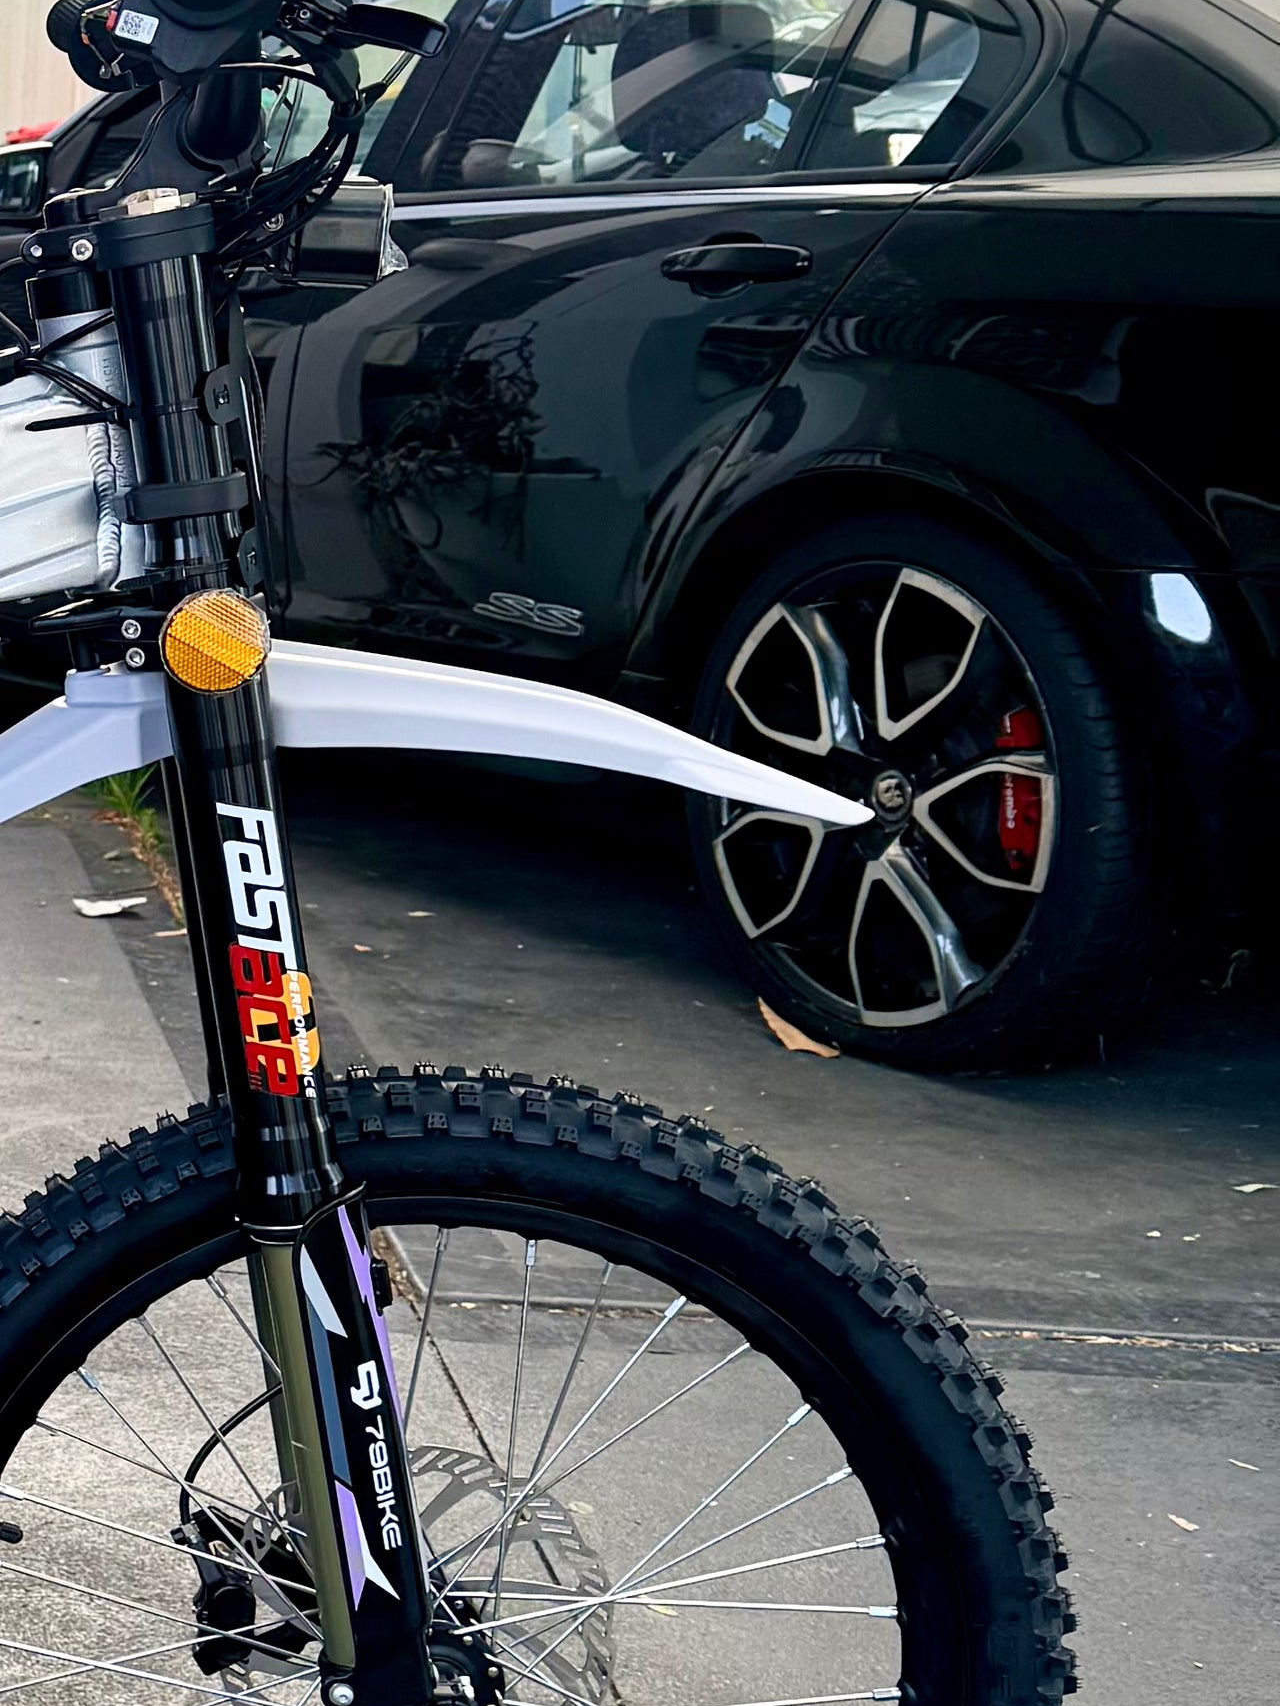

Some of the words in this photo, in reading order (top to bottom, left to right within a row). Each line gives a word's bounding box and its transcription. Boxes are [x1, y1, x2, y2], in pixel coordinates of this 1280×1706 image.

[472, 592, 584, 636] SS
[287, 970, 317, 1099] PERFORMANCE
[365, 1414, 403, 1550] 79BIKE
